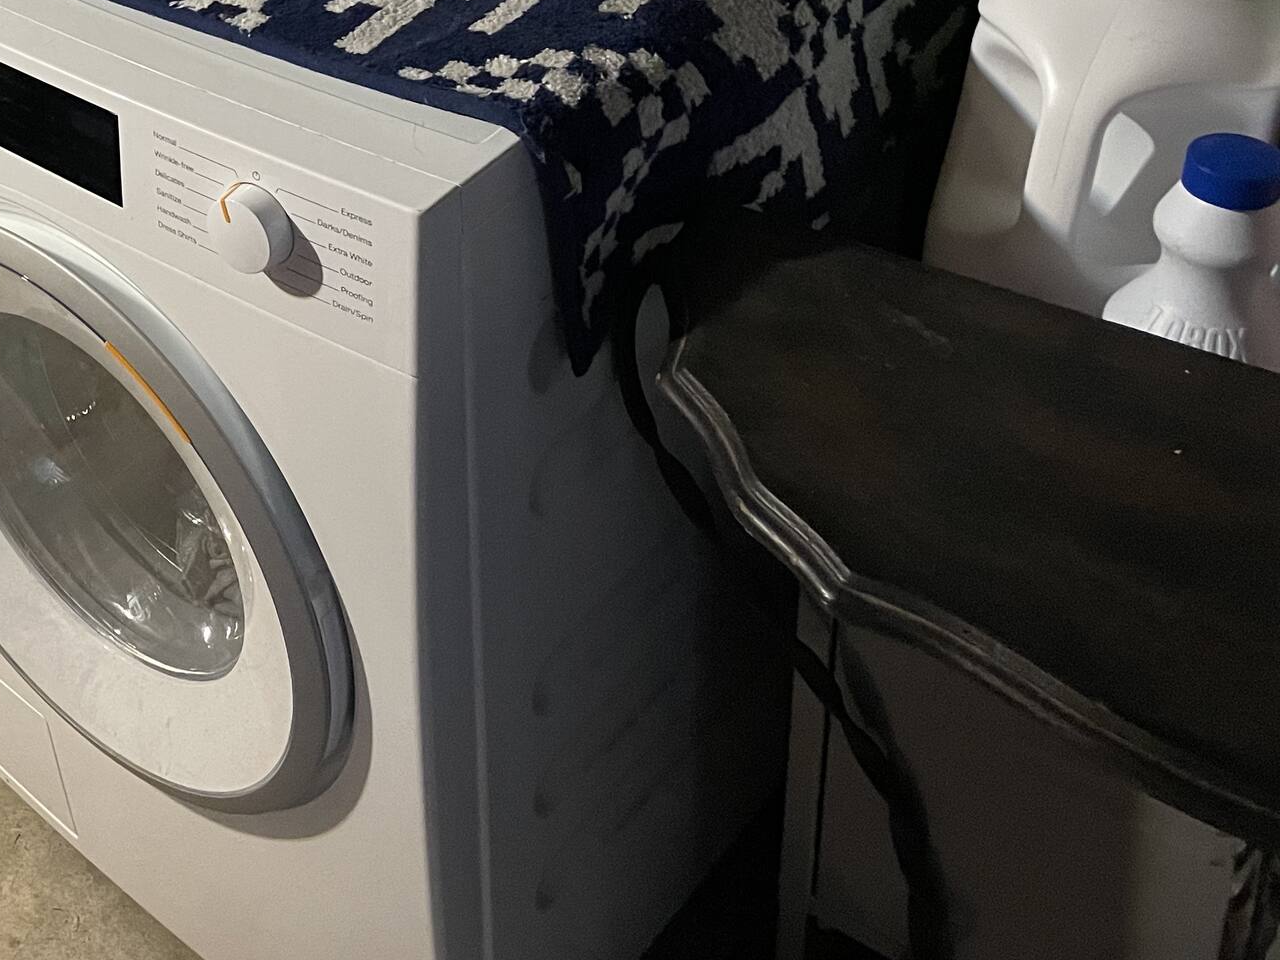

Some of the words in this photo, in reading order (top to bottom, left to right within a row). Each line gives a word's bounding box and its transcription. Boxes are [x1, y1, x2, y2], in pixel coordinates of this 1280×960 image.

[341, 208, 373, 227] Express
[328, 243, 348, 257] Extra
[349, 252, 373, 267] White
[340, 268, 373, 287] Outdoor
[340, 286, 373, 308] Proofing
